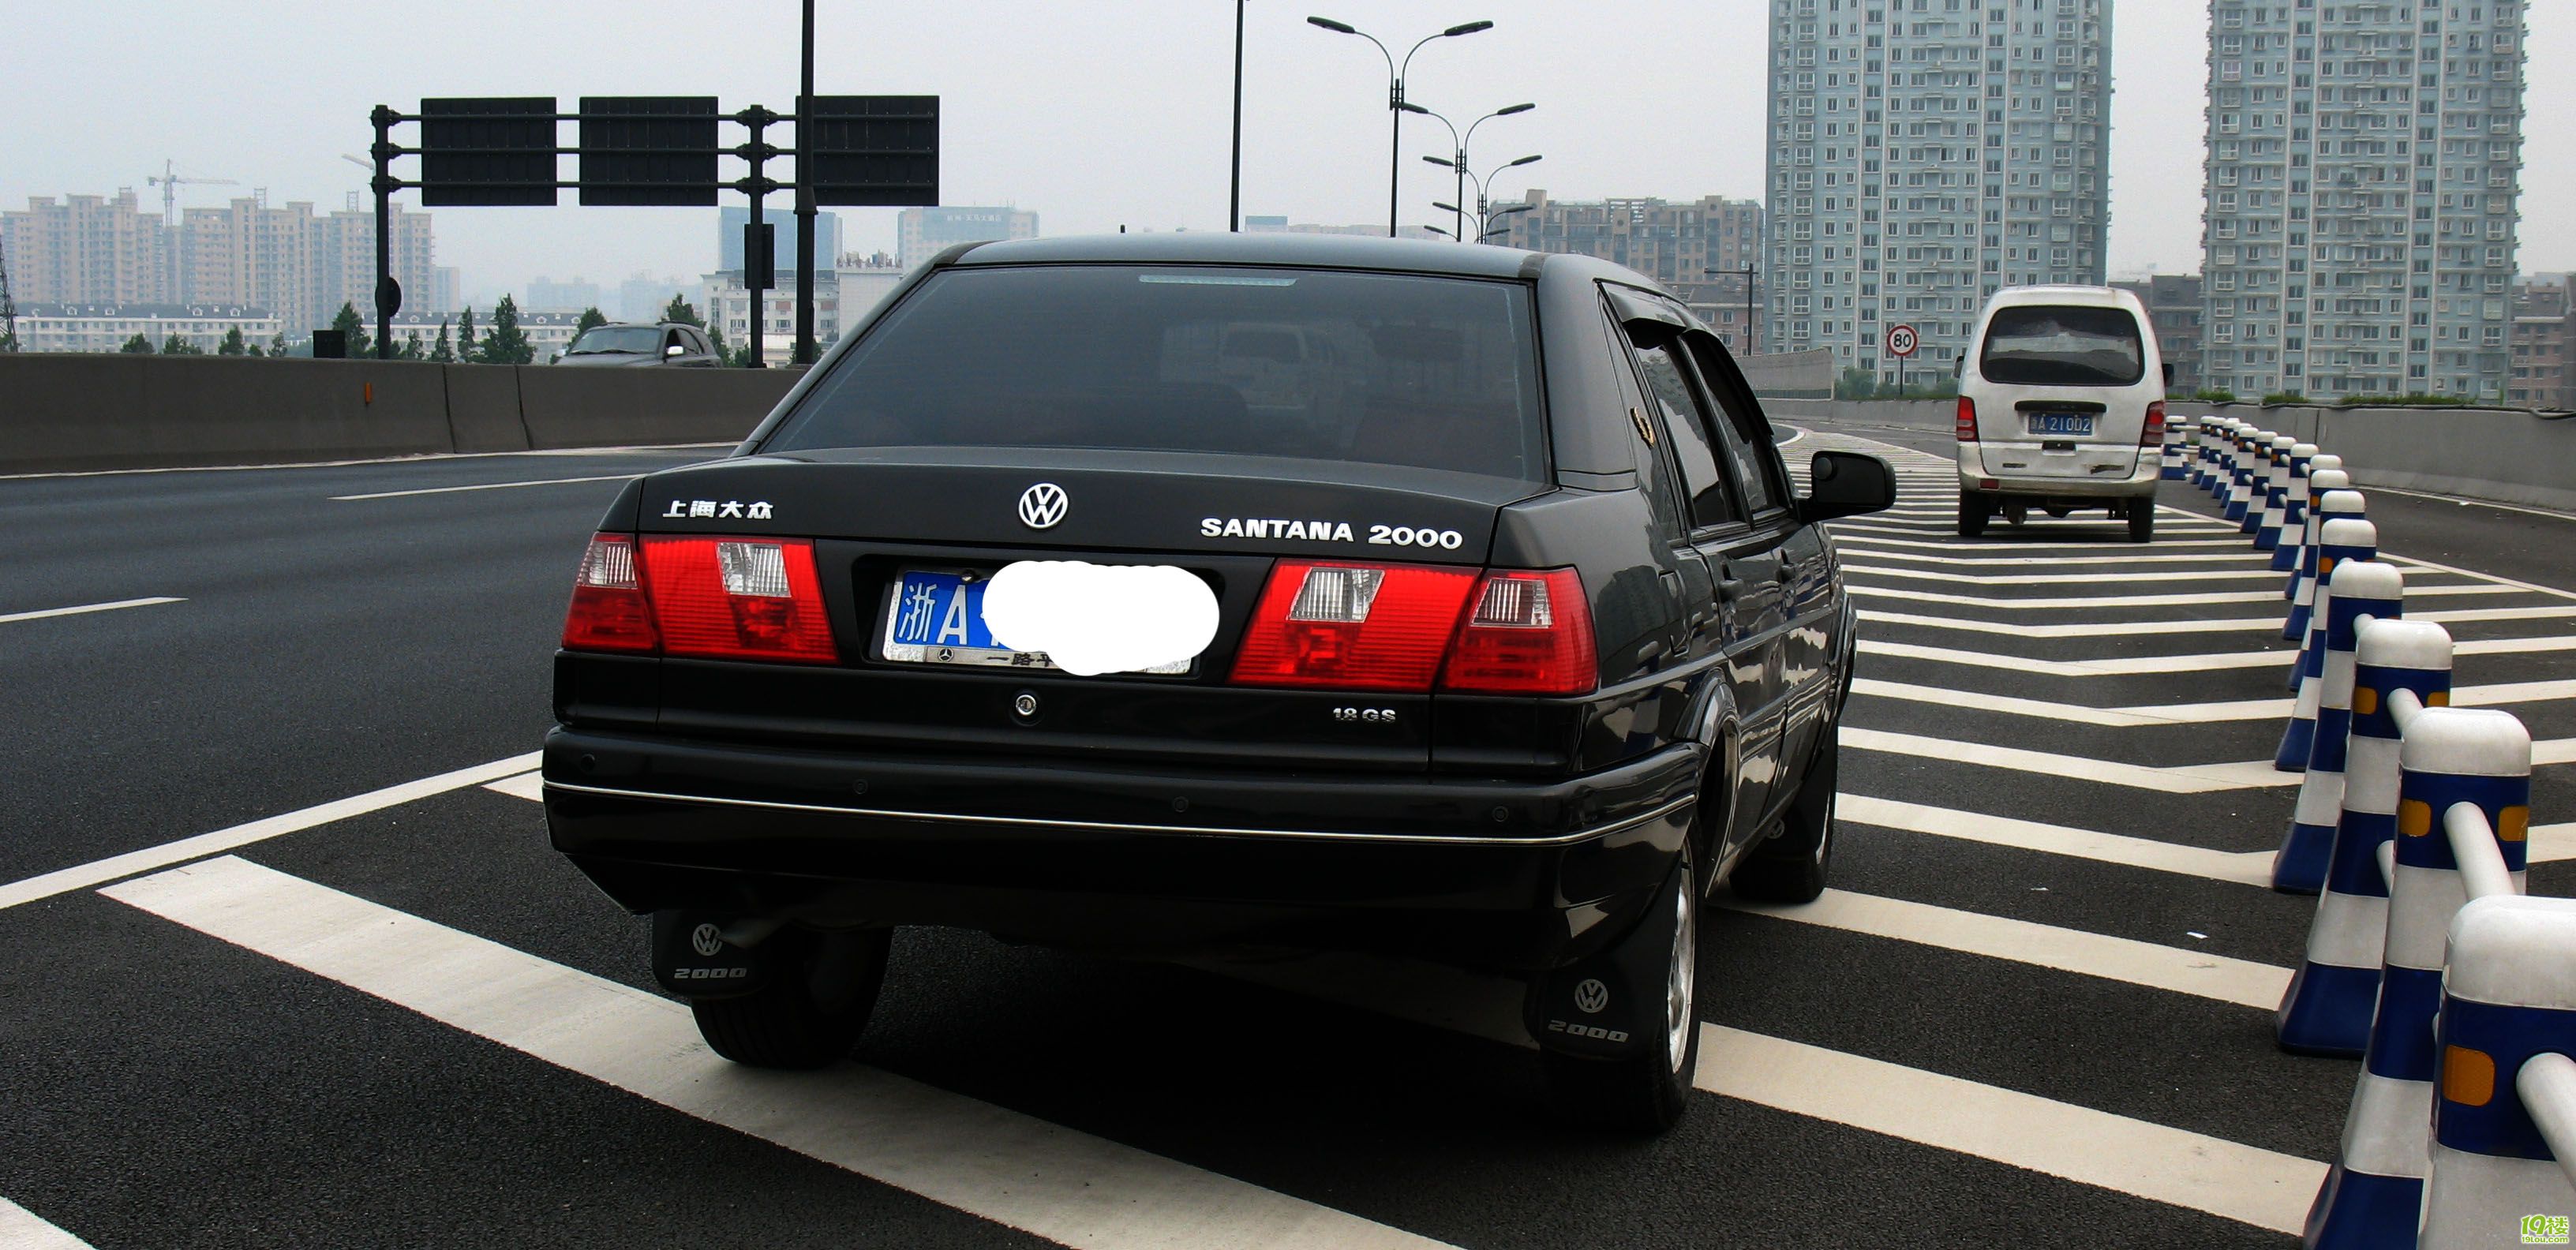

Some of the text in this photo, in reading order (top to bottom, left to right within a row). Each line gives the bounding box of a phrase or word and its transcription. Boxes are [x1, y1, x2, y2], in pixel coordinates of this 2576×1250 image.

[1894, 333, 1911, 347] 80
[662, 500, 773, 519] 上海大众
[1200, 518, 1463, 550] SANTANA 2000
[1362, 709, 1396, 723] GS
[674, 967, 747, 979] 2000
[1548, 1020, 1629, 1042] 2000
